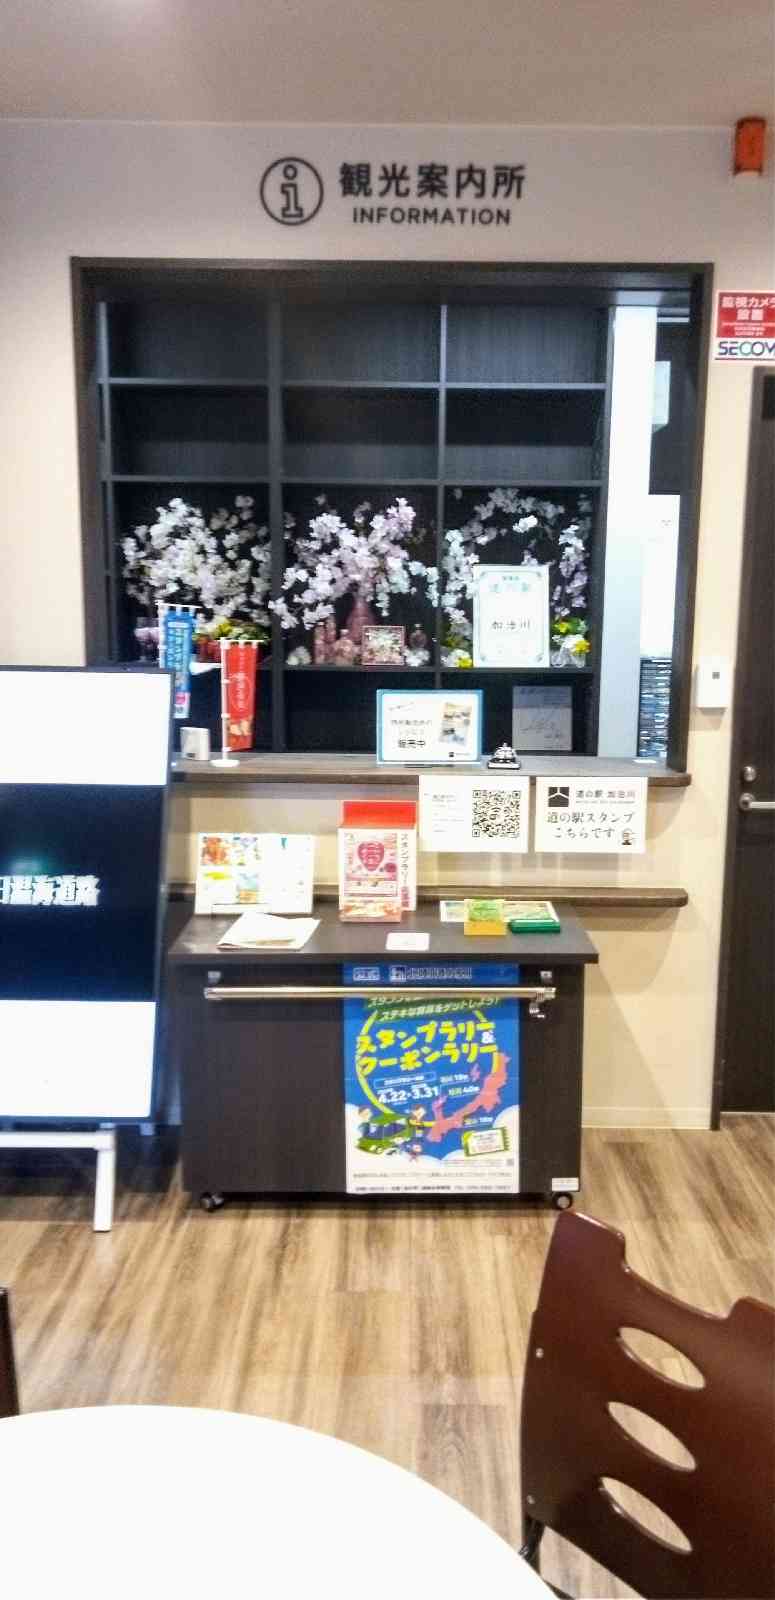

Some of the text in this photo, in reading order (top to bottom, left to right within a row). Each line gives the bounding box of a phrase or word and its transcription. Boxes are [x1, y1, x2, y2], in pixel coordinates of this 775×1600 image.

[339, 162, 526, 200] 観光案内所
[352, 206, 511, 226] INFORMATION
[547, 810, 635, 824] 道の駅スタンプ
[553, 827, 615, 839] こちらです
[357, 1020, 496, 1054] スタンプラリー
[358, 1042, 498, 1077] クーポンラリー
